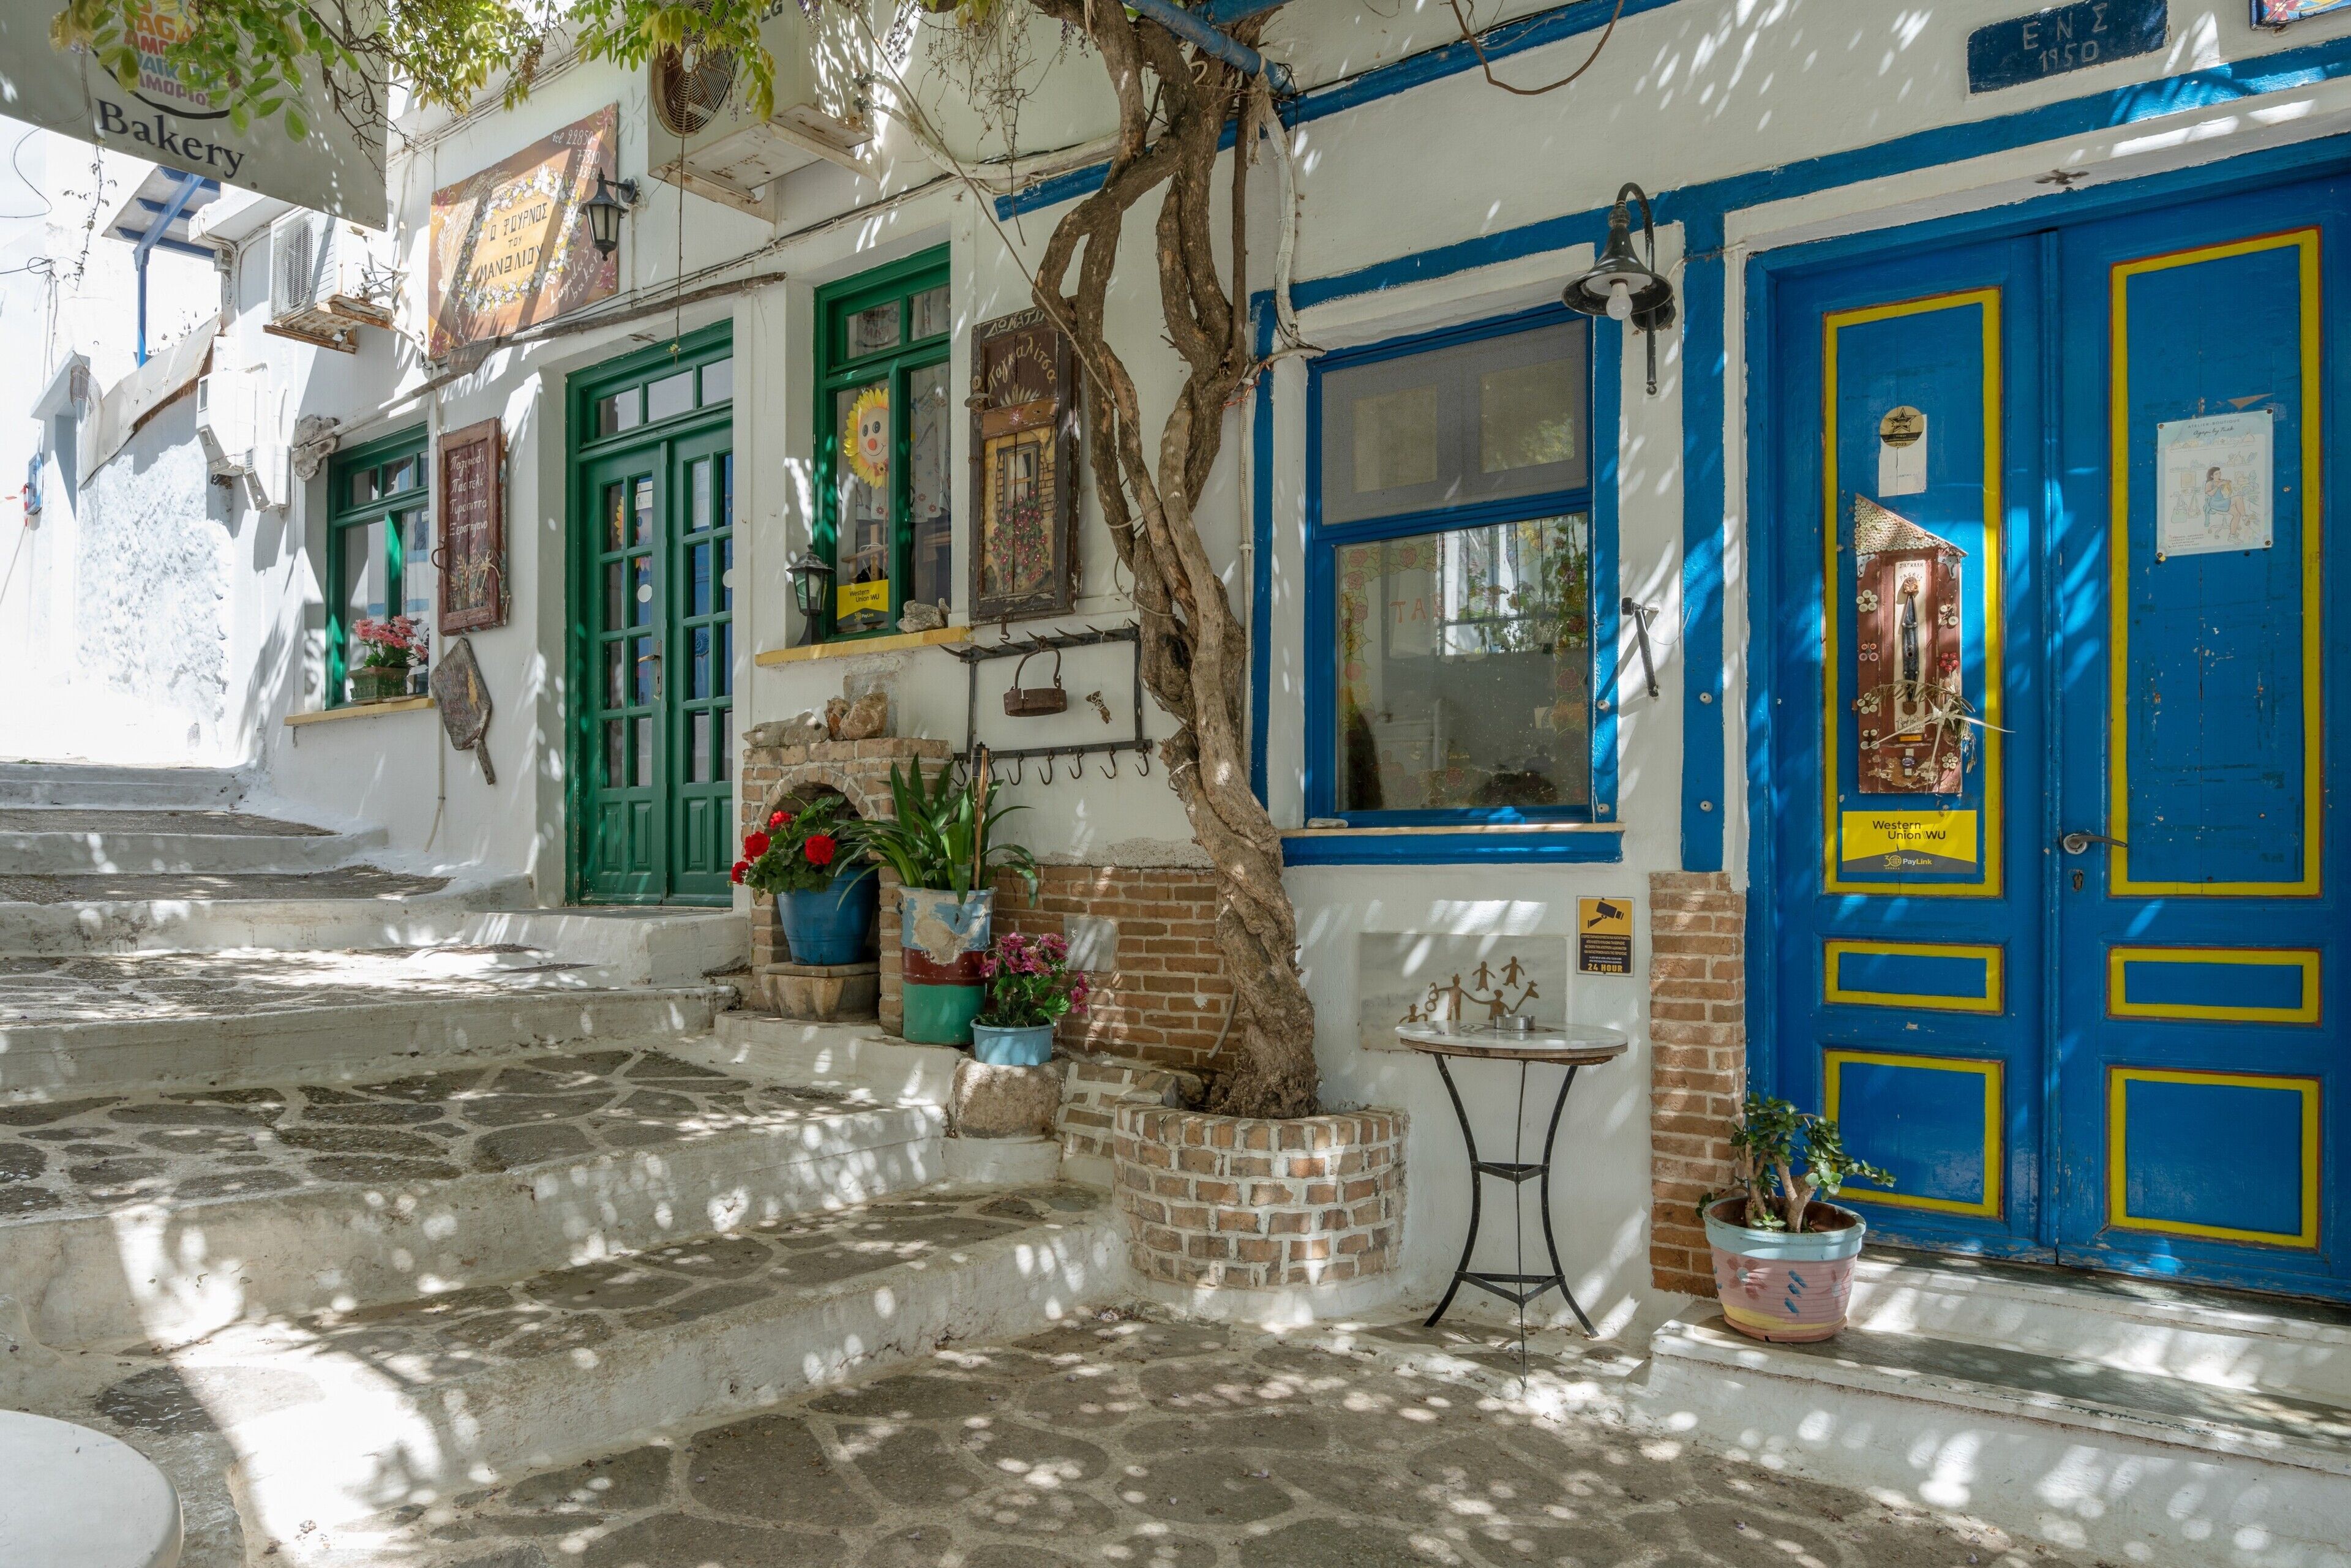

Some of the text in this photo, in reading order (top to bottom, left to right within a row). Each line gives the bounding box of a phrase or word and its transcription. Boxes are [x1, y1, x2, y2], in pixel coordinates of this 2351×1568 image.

[2039, 40, 2099, 72] 1950
[96, 98, 244, 179] Bakery
[503, 202, 548, 236] ΦΟΥΡΝΟΣ
[508, 236, 522, 248] ΤΟΥ
[571, 251, 603, 302] baker
[1872, 820, 1921, 830] Western
[1888, 831, 1946, 839] Union WU
[1601, 964, 1622, 972] HOUR
